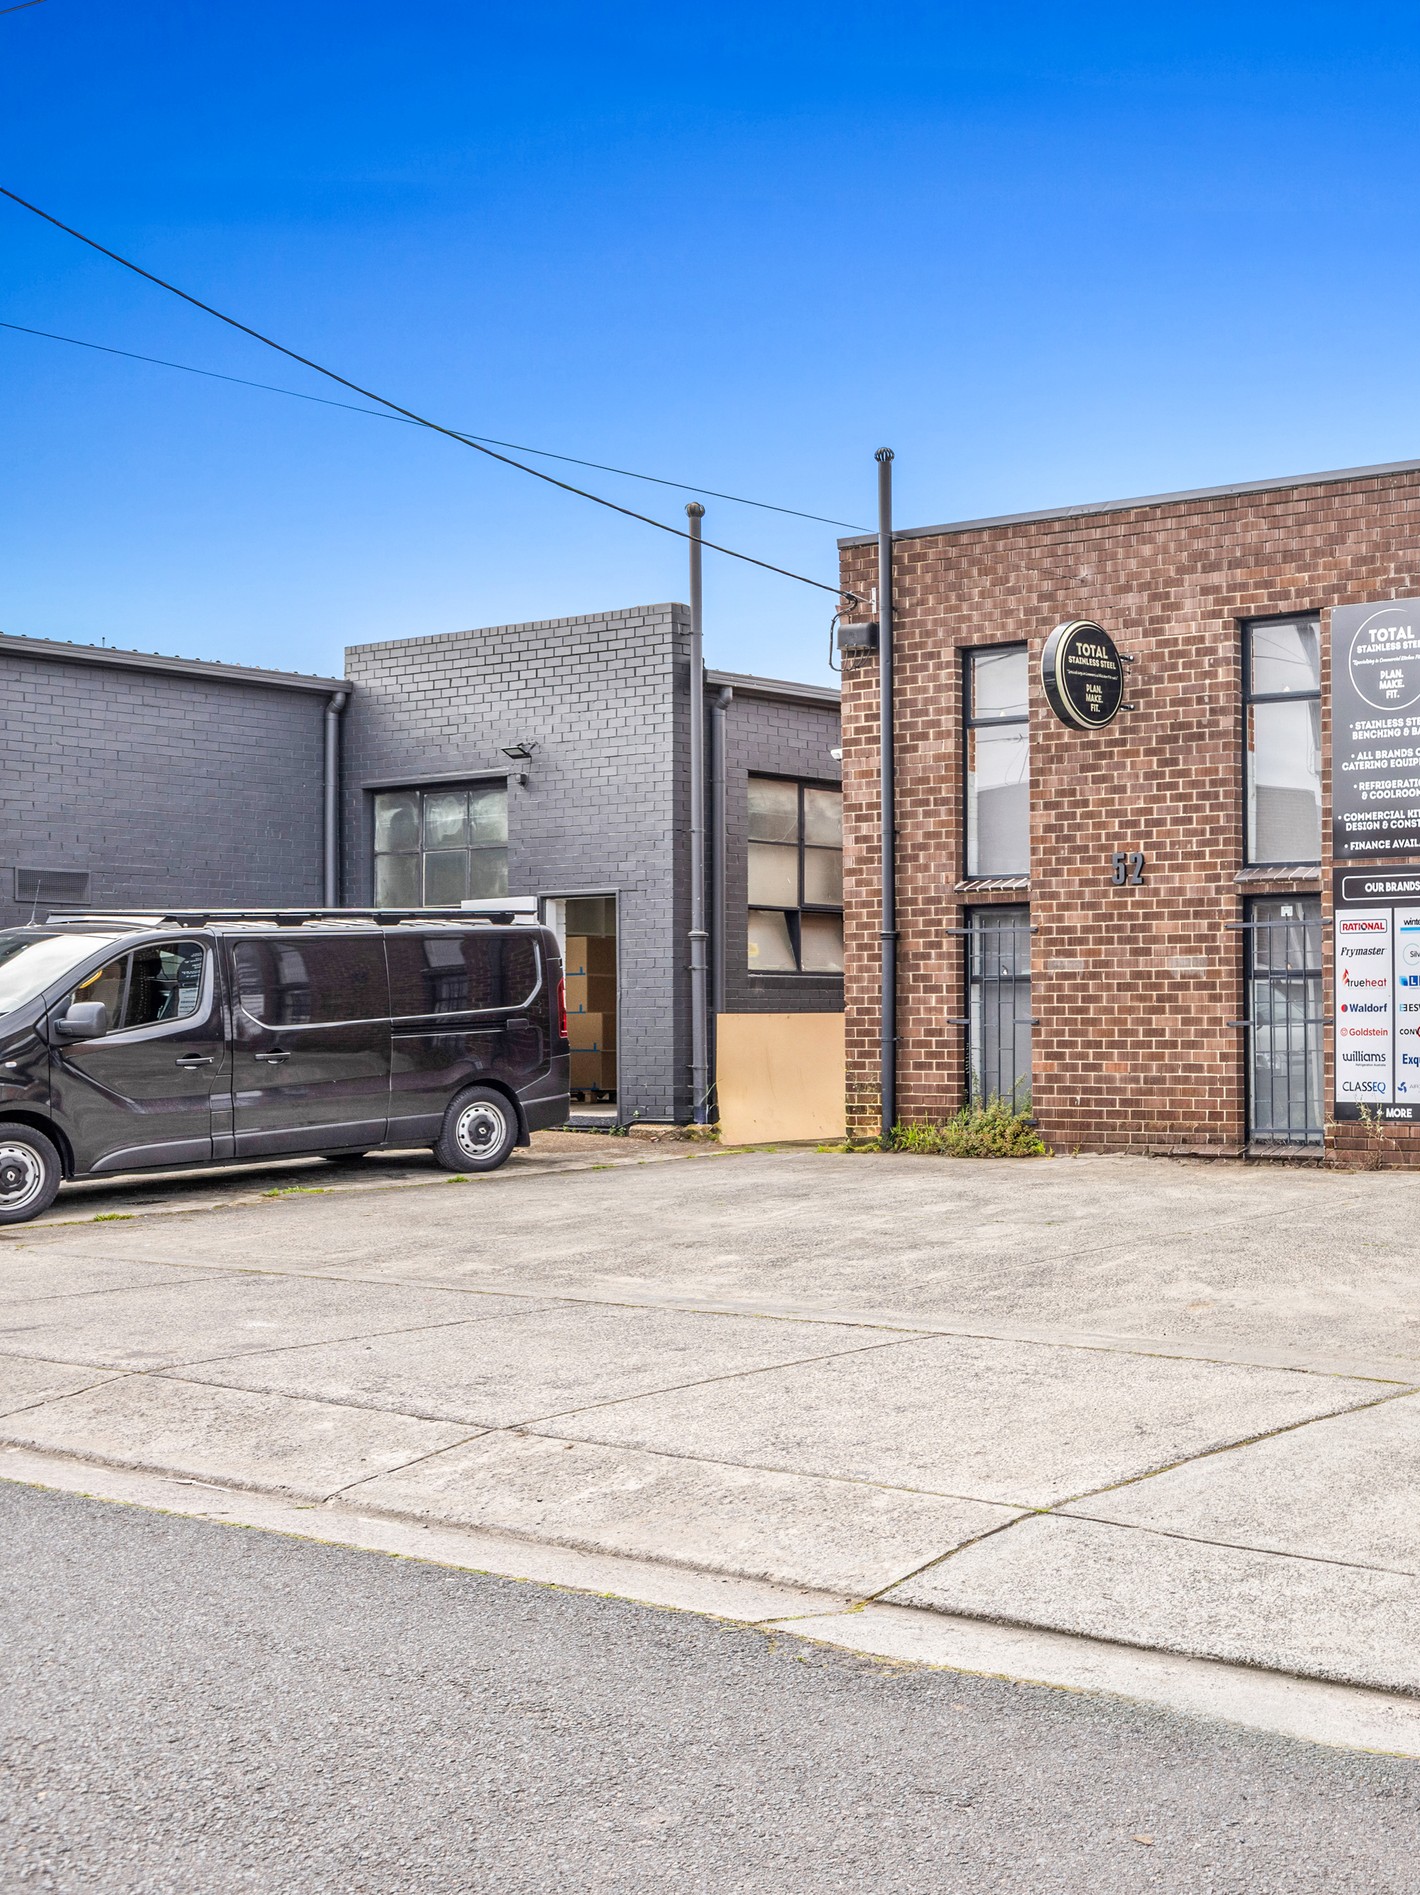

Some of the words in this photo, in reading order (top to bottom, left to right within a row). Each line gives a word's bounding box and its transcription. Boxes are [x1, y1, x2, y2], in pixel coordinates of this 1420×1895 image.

[1368, 625, 1415, 643] TOTAL
[1076, 642, 1108, 659] TOTAL
[1356, 641, 1401, 654] STAINLESS
[1068, 655, 1100, 667] STAINLESS
[1100, 660, 1117, 670] STEEL
[1380, 668, 1404, 680] PLAN.
[1379, 679, 1405, 690] MAKE.
[1085, 693, 1104, 704] MAKE.
[1385, 689, 1400, 699] FIT.
[1354, 717, 1404, 731] STAINLESS
[1352, 727, 1401, 741] BENCHING
[1403, 727, 1410, 737] &
[1356, 751, 1373, 761] ALL
[1375, 748, 1414, 759] BRANDS
[1341, 759, 1388, 771] CATERING
[1361, 791, 1368, 800] &
[1343, 809, 1406, 822] COMMERCIAL
[1345, 821, 1380, 832] DESIGN
[1382, 820, 1389, 830] &
[1350, 839, 1391, 851] FINANCE
[1112, 852, 1144, 885] 52
[1364, 882, 1385, 893] OUR
[1385, 880, 1420, 892] BRANDS
[1342, 922, 1385, 931] RATIONAL
[1340, 946, 1386, 958] Frymaster
[1347, 977, 1387, 987] trueheat
[1349, 1003, 1388, 1013] Waldorf
[1349, 1027, 1389, 1037] Goldstein
[1342, 1050, 1386, 1062] williams
[1342, 1081, 1386, 1094] CLASSEQ
[1385, 1107, 1413, 1118] MORE
